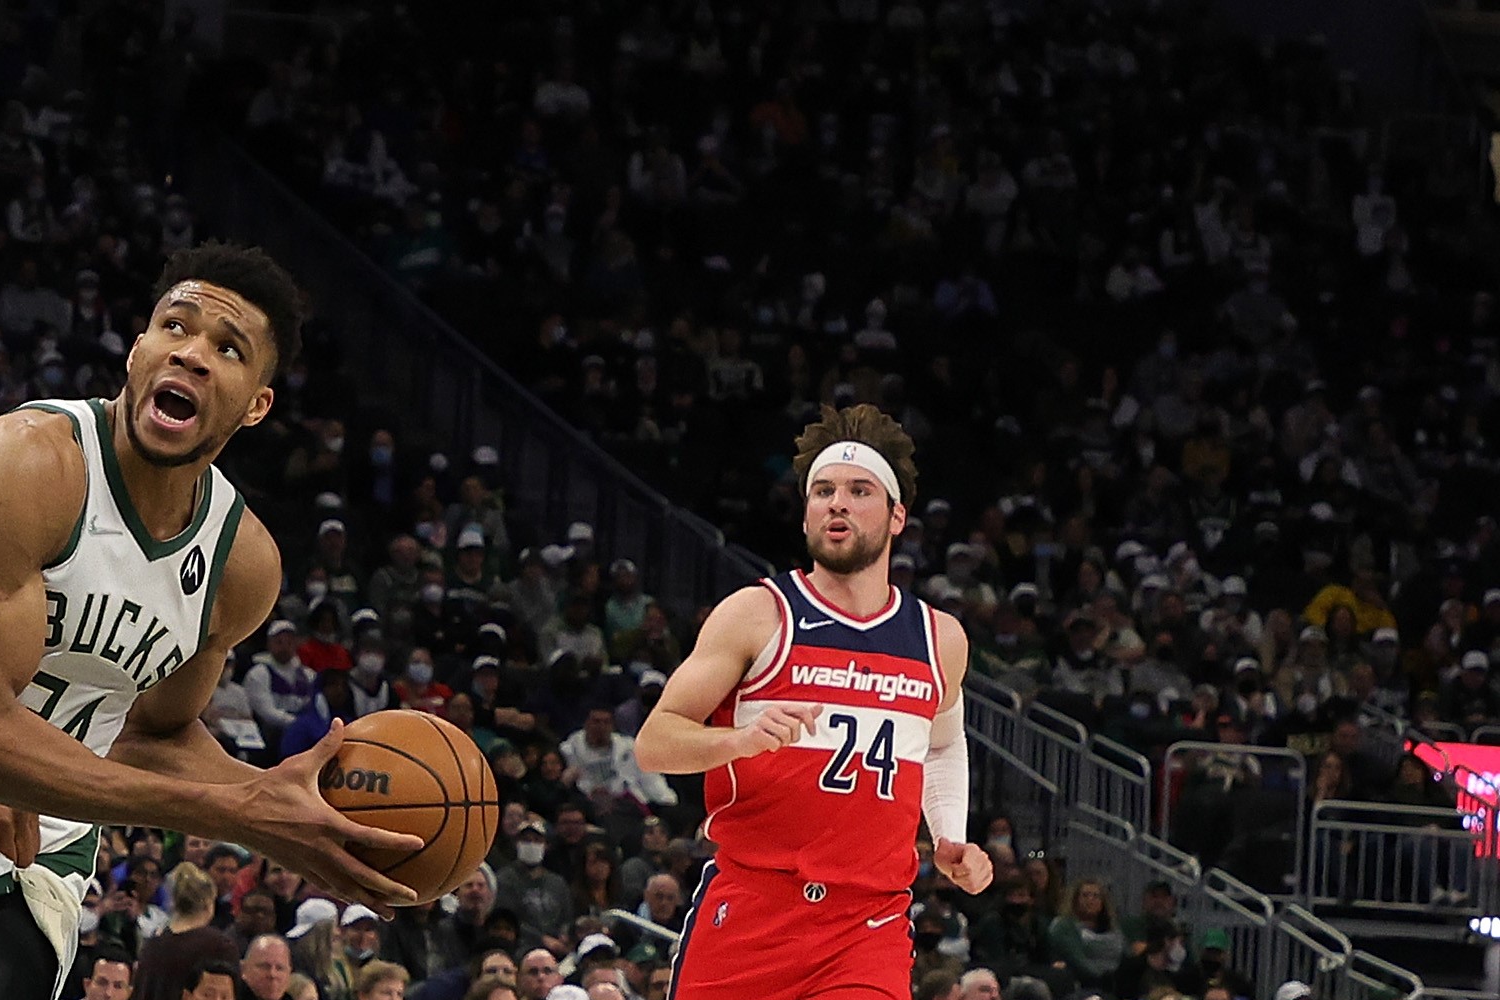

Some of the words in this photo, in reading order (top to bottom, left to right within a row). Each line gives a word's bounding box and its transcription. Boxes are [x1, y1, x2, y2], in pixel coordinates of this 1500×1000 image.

[45, 589, 183, 692] BUCKS
[792, 660, 932, 701] washington
[319, 756, 389, 795] lson
[820, 713, 898, 800] 24
